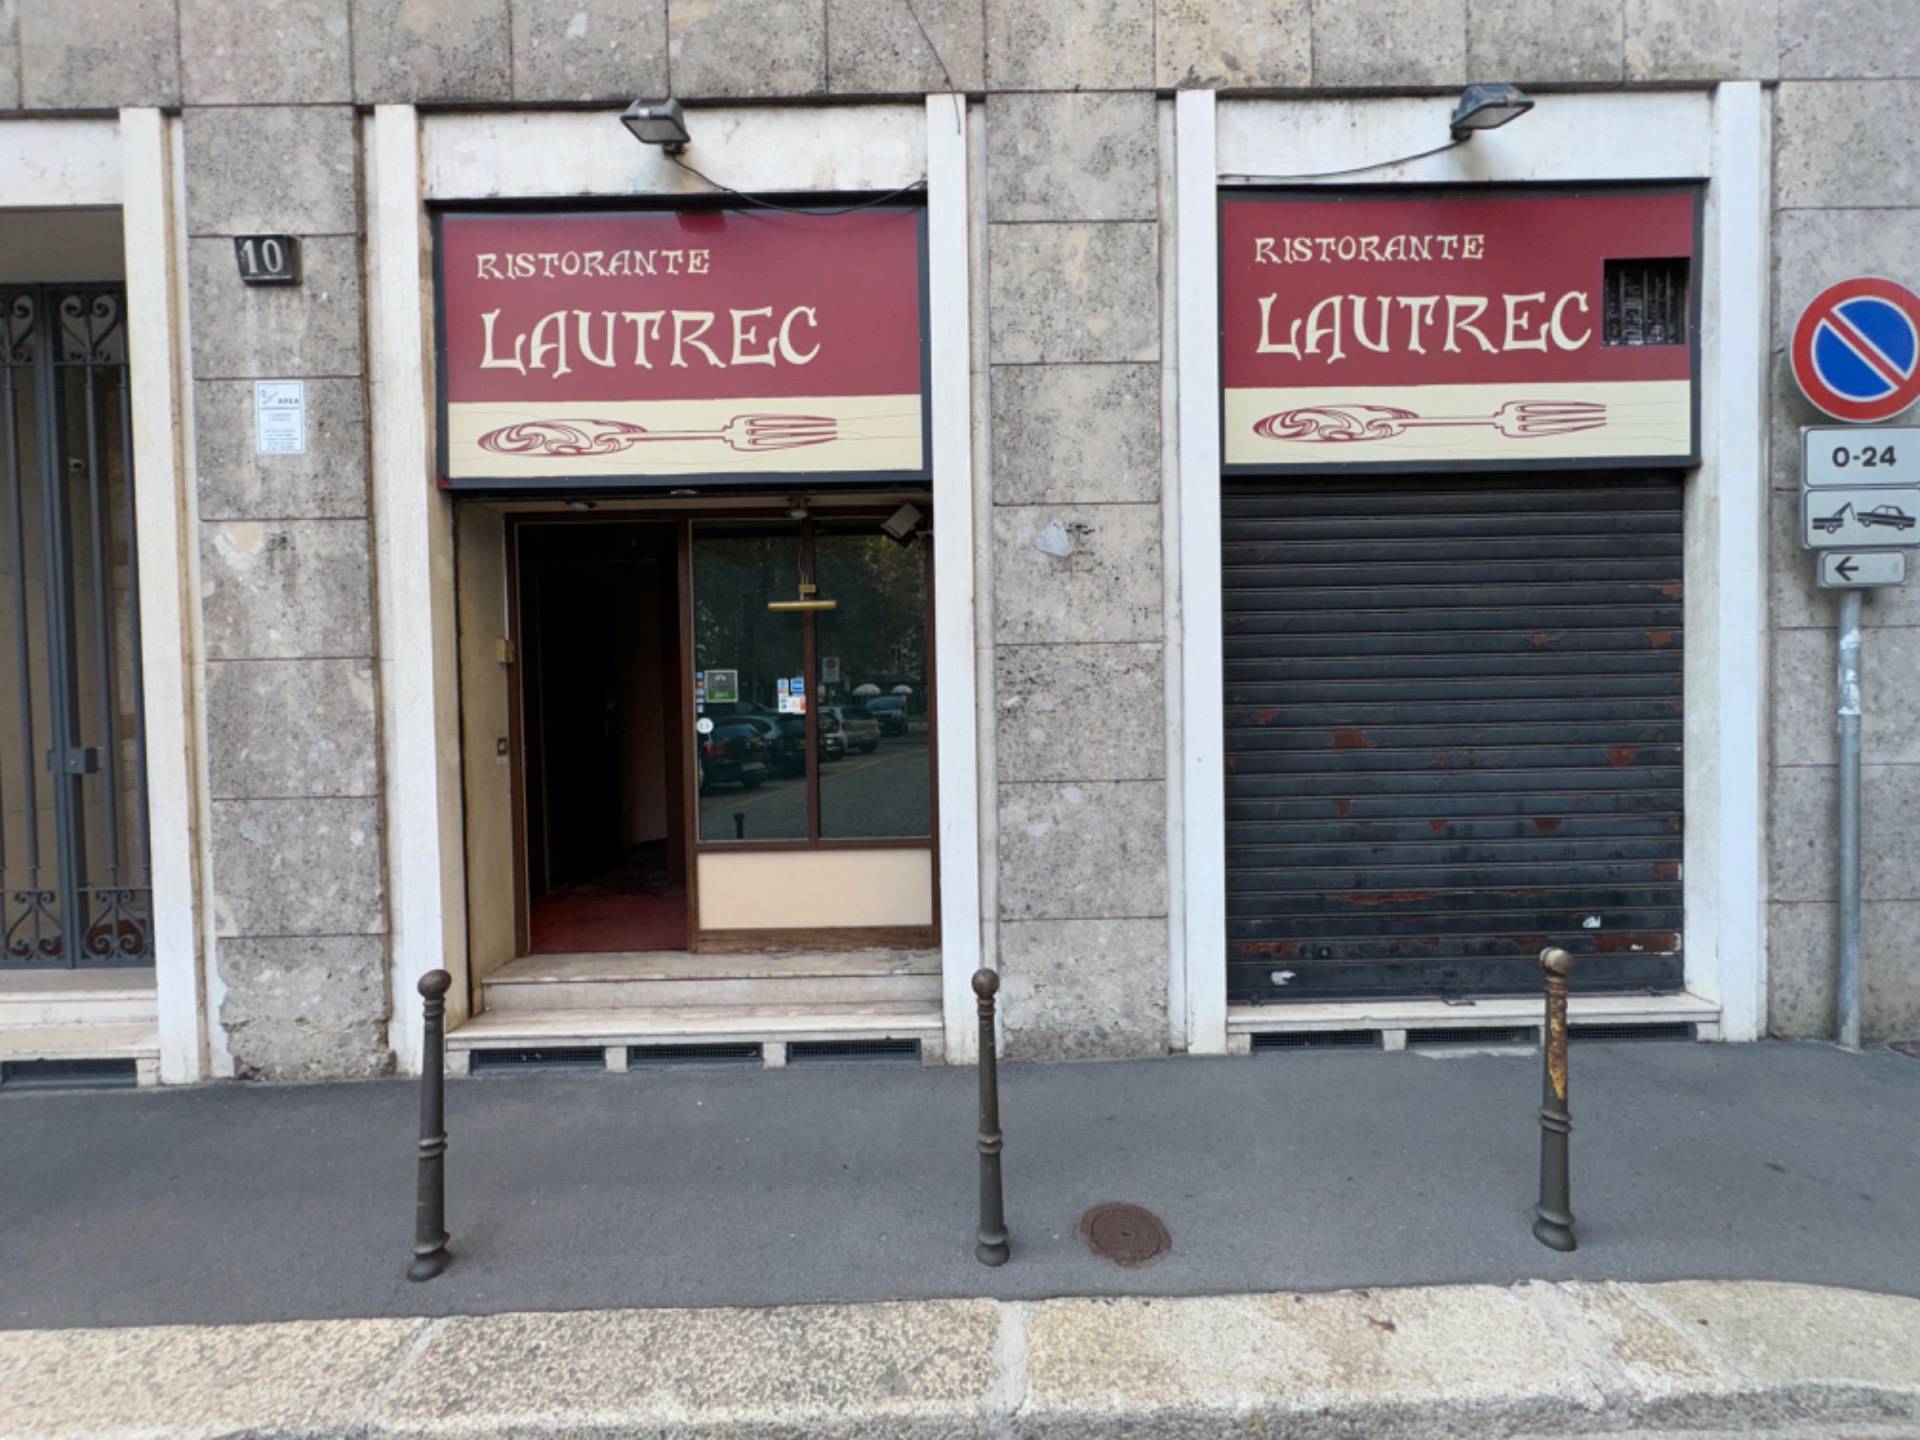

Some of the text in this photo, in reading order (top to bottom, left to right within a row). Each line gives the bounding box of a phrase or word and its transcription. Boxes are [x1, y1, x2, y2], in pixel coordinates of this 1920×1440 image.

[242, 238, 283, 274] 10
[476, 248, 710, 280] RISTORANTE
[1254, 234, 1485, 264] RISTORANTE
[479, 305, 821, 379] LAUTREC
[1256, 290, 1592, 365] LAUTREC
[1832, 445, 1897, 468] 0-24
